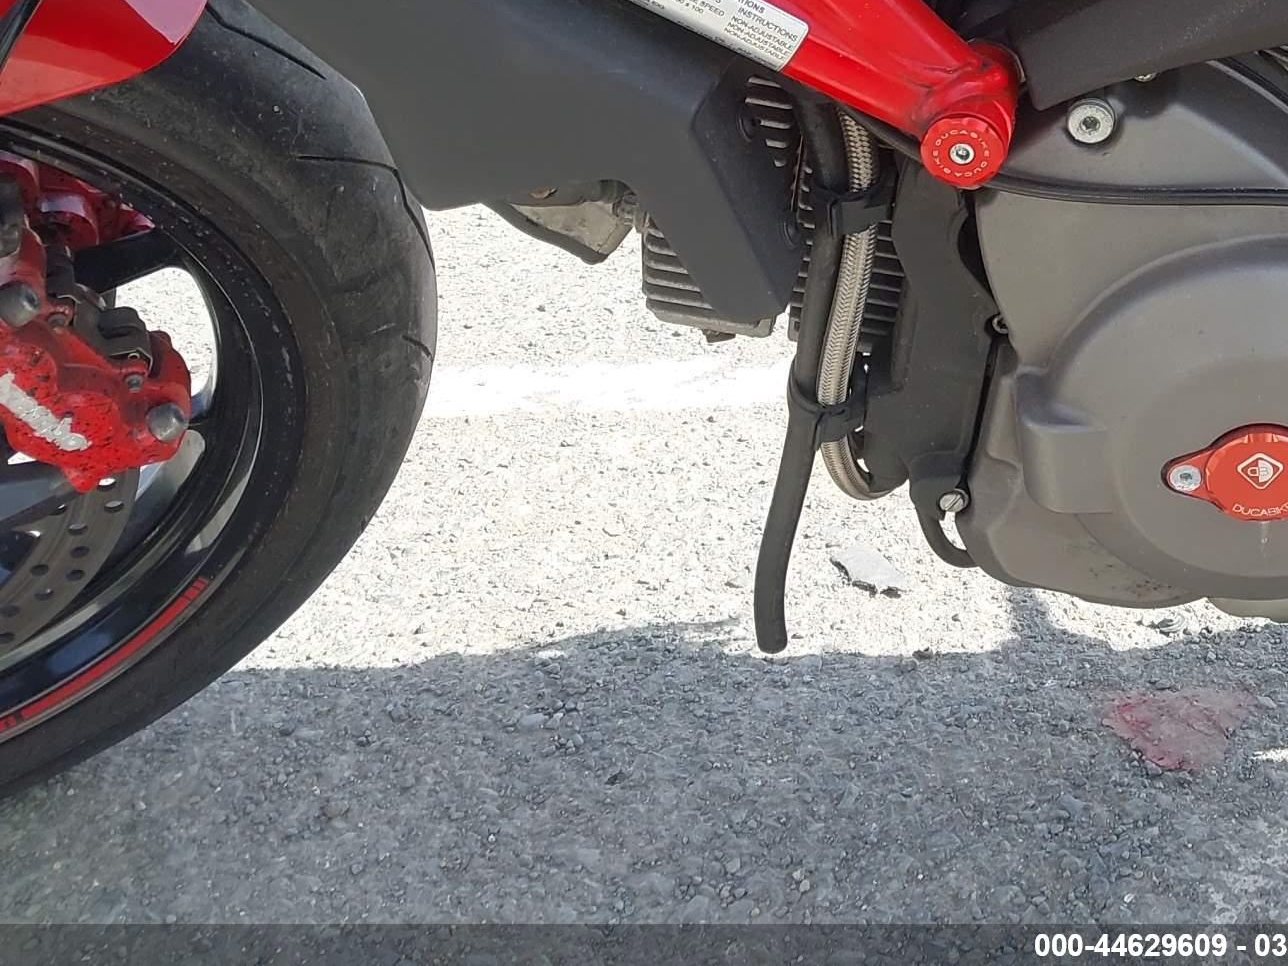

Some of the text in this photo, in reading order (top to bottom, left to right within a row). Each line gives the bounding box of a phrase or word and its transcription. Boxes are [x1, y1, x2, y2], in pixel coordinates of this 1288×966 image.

[698, 0, 725, 17] SPEED
[731, 15, 794, 52] NON-ADJUSTABLE
[727, 20, 788, 57] NON-ADJUSTABLE
[737, 5, 798, 43] INSTRUCTIONS
